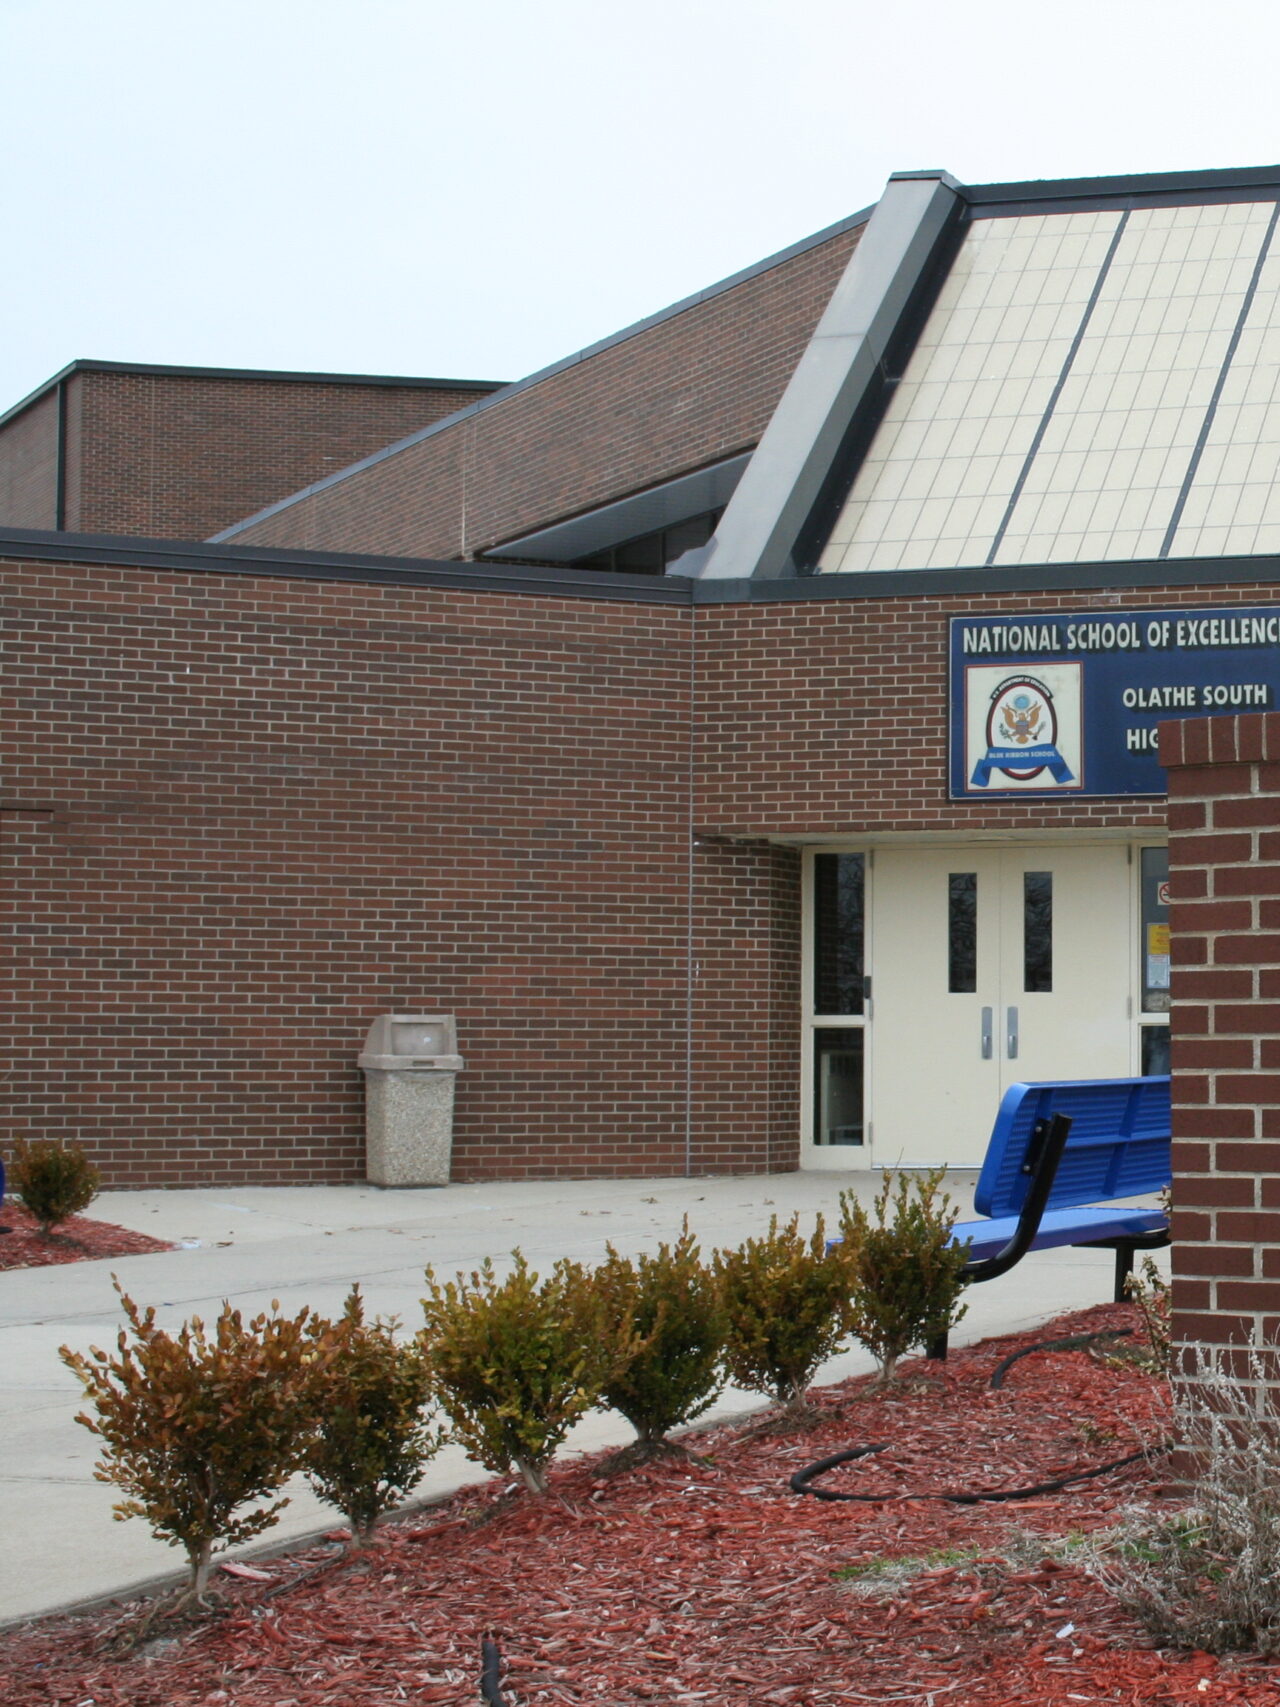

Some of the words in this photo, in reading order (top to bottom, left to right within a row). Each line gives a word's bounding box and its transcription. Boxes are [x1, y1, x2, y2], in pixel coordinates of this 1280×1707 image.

[963, 625, 1060, 653] NATIONAL
[1067, 622, 1140, 650] SCHOOL
[1147, 621, 1170, 647] OF
[1122, 686, 1196, 708] OLATHE
[1203, 684, 1267, 705] SOUTH
[1127, 728, 1158, 750] HIG
